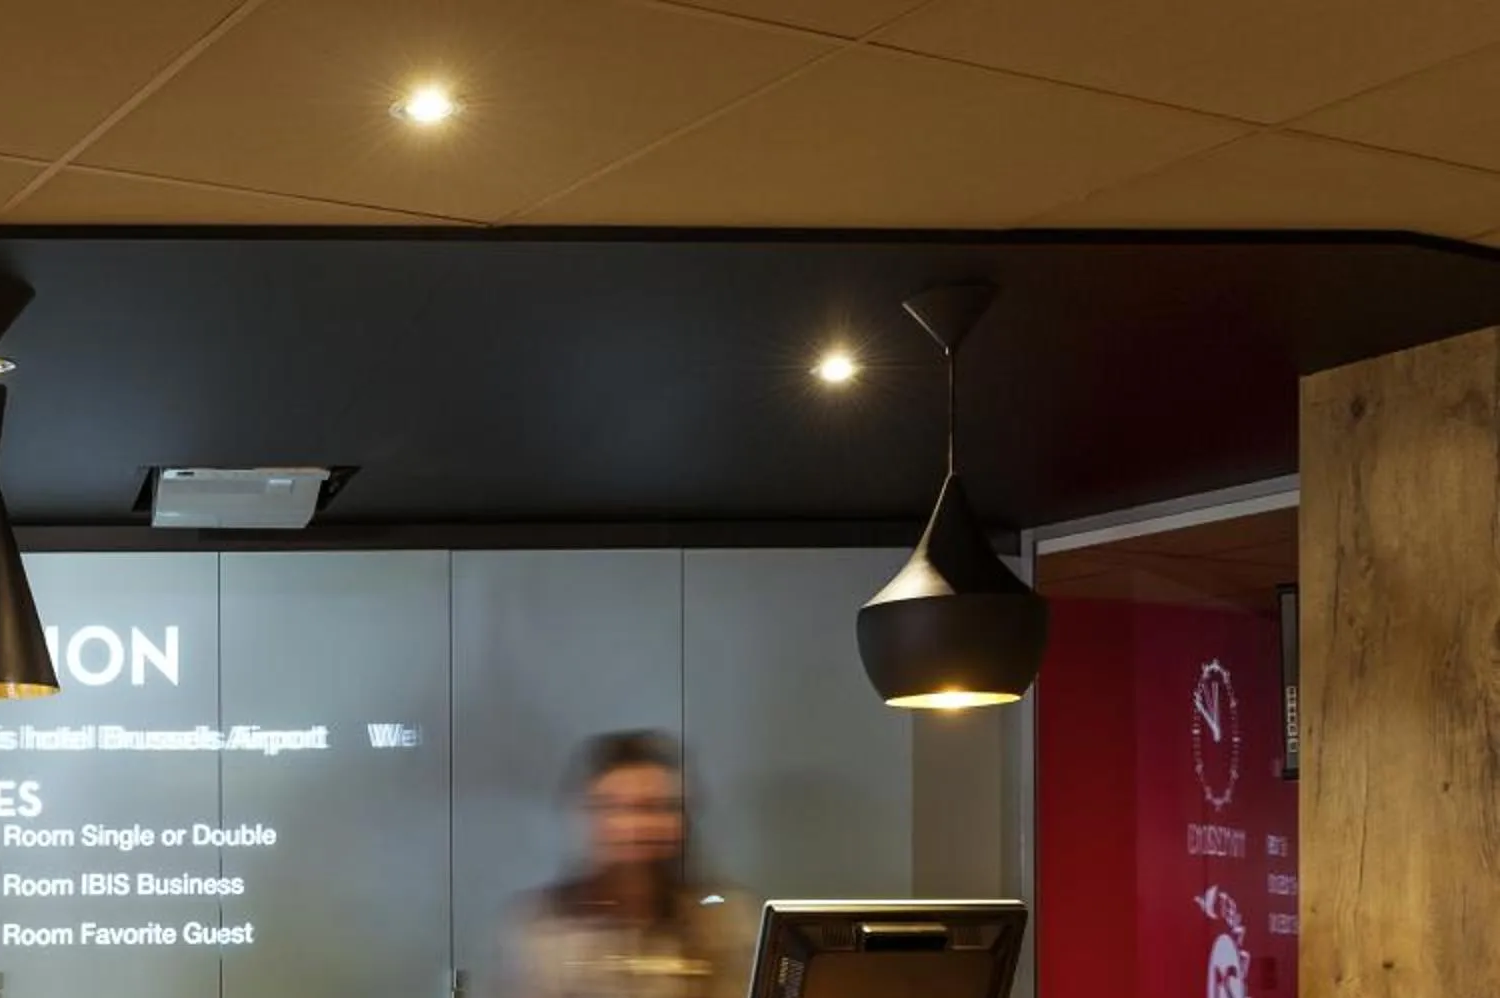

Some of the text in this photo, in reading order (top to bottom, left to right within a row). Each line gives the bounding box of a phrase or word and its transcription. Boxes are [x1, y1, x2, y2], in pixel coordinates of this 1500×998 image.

[3, 823, 277, 851] Room Single or Double
[2, 872, 245, 897] Room IBIS Business
[2, 921, 255, 946] Room Favorite Guest
